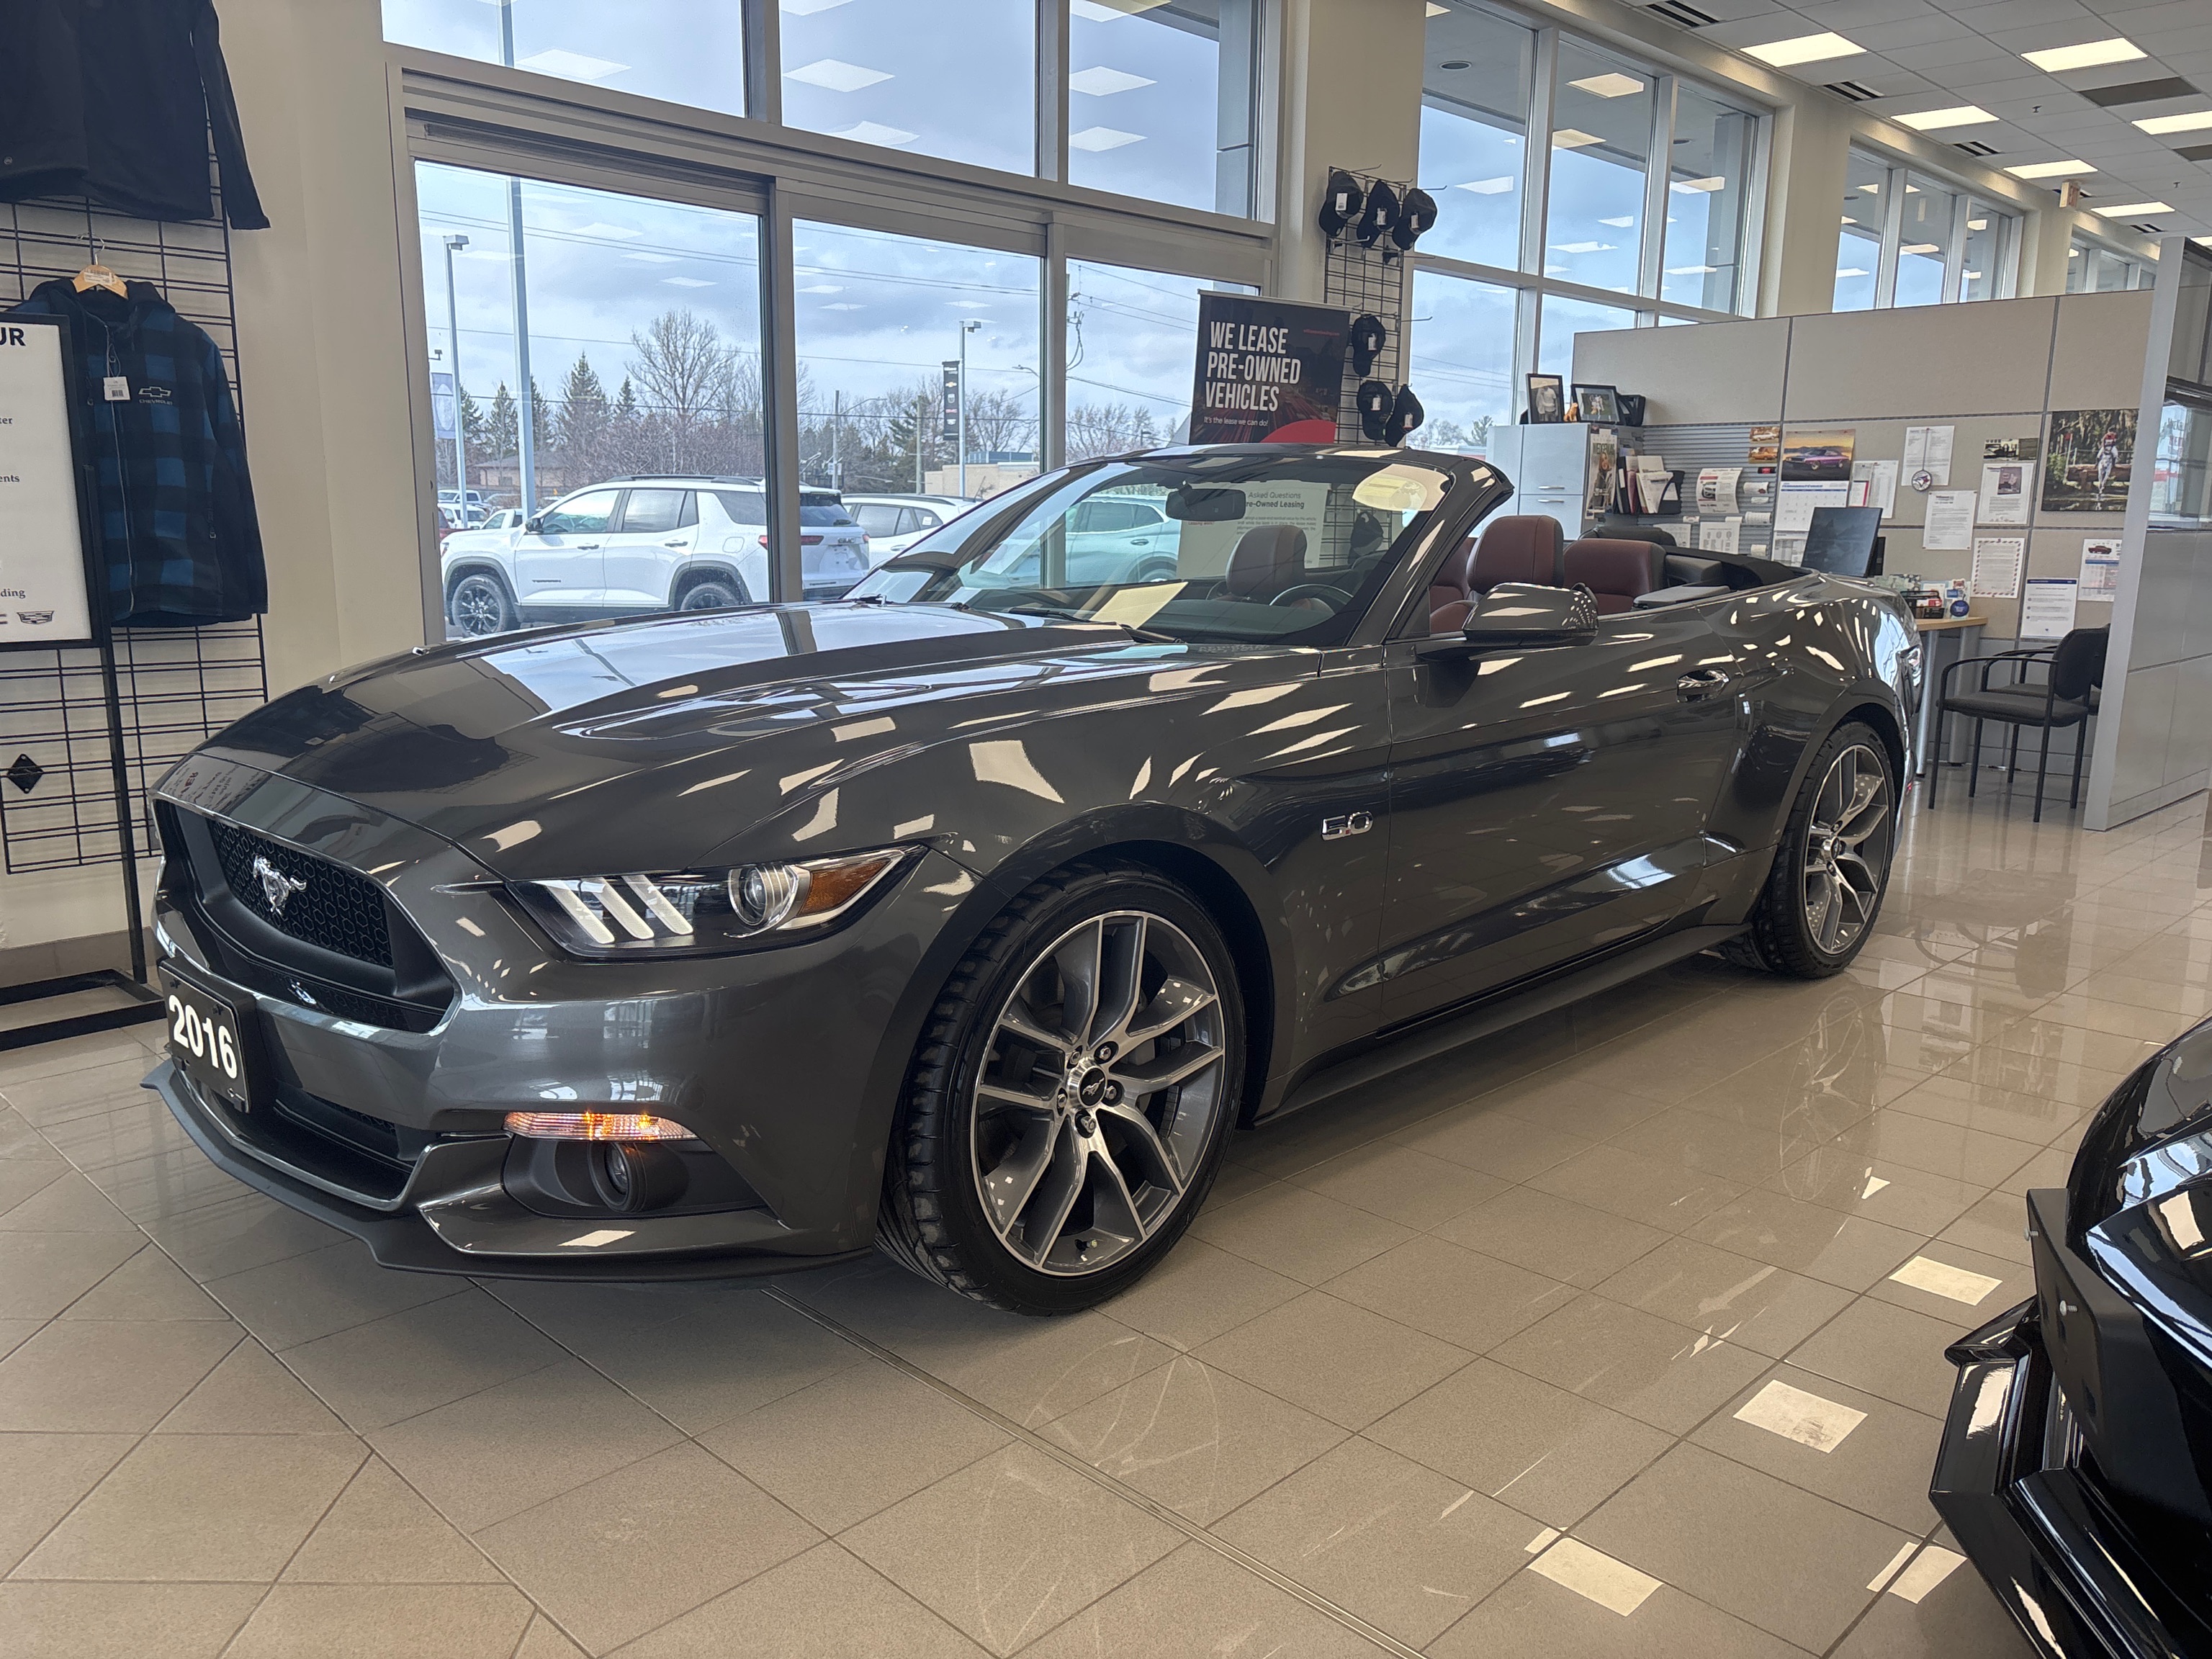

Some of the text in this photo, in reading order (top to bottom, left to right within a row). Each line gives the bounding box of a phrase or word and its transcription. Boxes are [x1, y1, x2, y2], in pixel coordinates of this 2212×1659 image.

[1210, 321, 1289, 354] WE LEASE
[1207, 351, 1301, 385] PRE-OWNED
[1205, 381, 1280, 412] VEHICLES
[1280, 500, 1305, 509] Leasing
[1321, 811, 1373, 841] 5.0
[168, 994, 238, 1079] 2016
